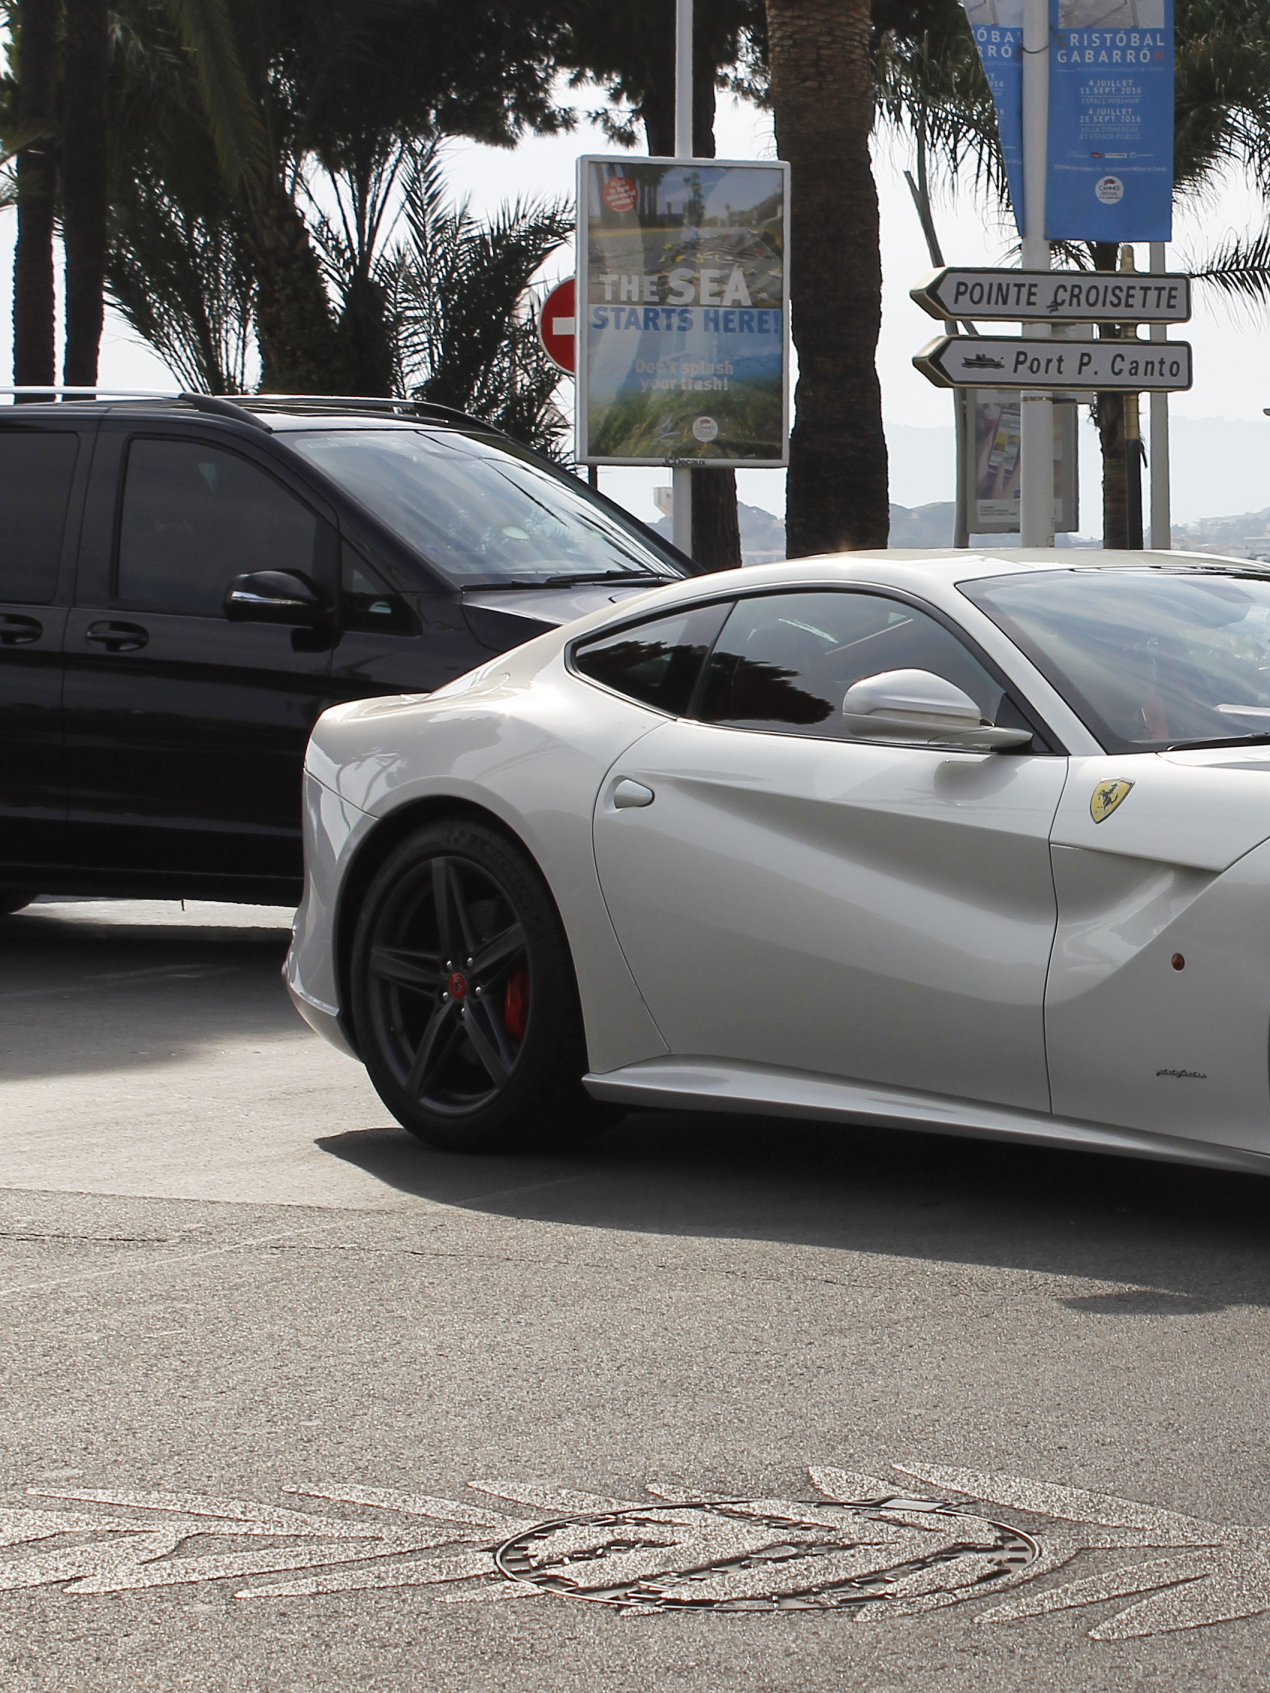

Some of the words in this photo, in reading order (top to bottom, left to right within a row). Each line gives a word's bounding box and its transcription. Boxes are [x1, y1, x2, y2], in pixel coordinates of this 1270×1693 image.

[1057, 30, 1165, 47] CRISTÓBAL
[1057, 47, 1165, 63] GABARRÓN
[1080, 87, 1090, 95] 11
[1093, 87, 1118, 95] SEPT.
[1121, 87, 1142, 95] 2016
[1088, 79, 1094, 87] 4
[1097, 79, 1134, 87] JUILLET
[1080, 115, 1090, 123] 25
[1093, 115, 1118, 123] SEPT.
[1120, 115, 1141, 123] 2016
[601, 274, 660, 302] THE
[667, 263, 752, 306] SEA
[954, 281, 1039, 307] POINTE
[1053, 283, 1179, 309] CROISETTE
[592, 306, 694, 332] STARTS
[704, 308, 781, 334] HERE!
[635, 359, 678, 374] Don't
[681, 360, 734, 379] splash
[1013, 351, 1064, 375] Port
[1077, 352, 1099, 376] P.
[1111, 353, 1181, 378] Canto
[641, 379, 677, 393] your
[681, 377, 729, 391] trash!
[662, 457, 706, 466] JCDecaux
